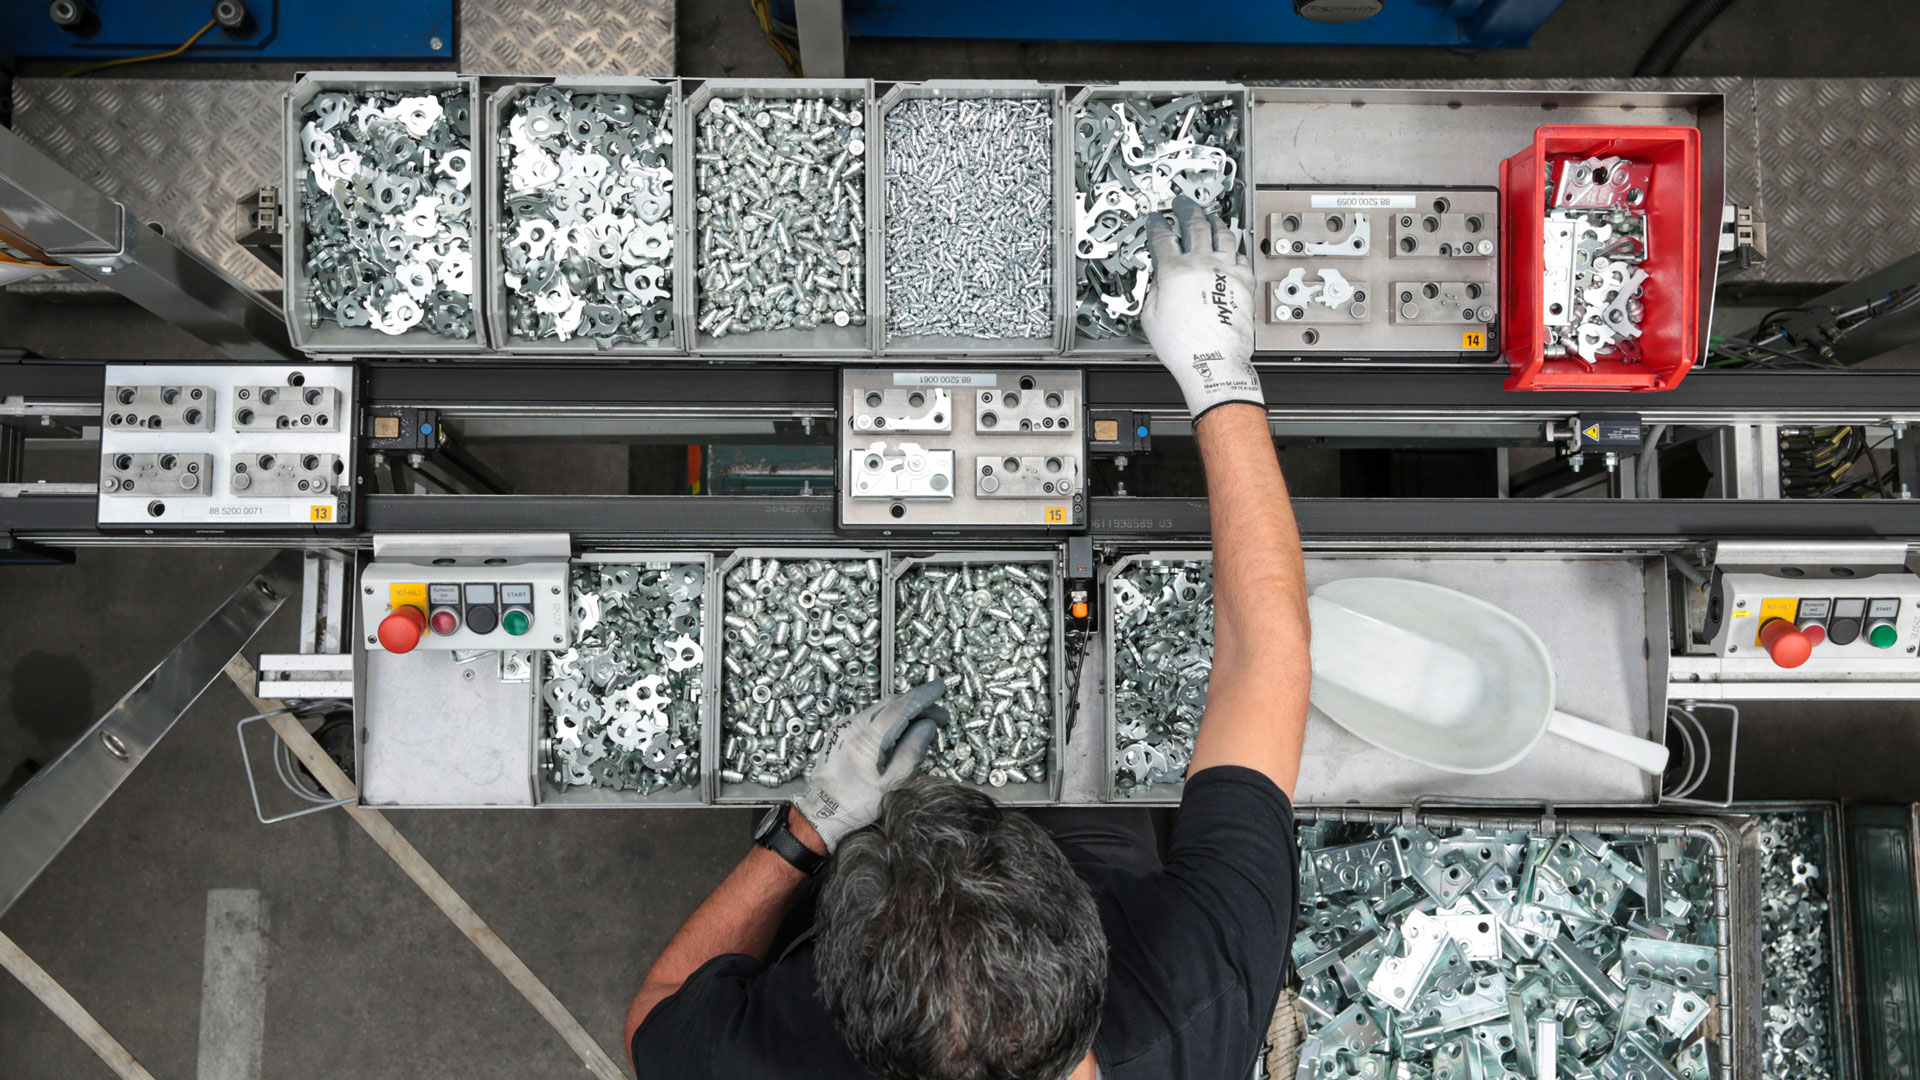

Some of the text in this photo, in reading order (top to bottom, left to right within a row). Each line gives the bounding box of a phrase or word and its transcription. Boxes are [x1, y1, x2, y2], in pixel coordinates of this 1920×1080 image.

[1211, 273, 1233, 326] HyFlex
[1466, 335, 1480, 347] 14
[1193, 350, 1223, 361] Ansell
[208, 507, 263, 515] 88.5200.0071
[314, 508, 327, 519] 13
[1048, 510, 1062, 520] 15
